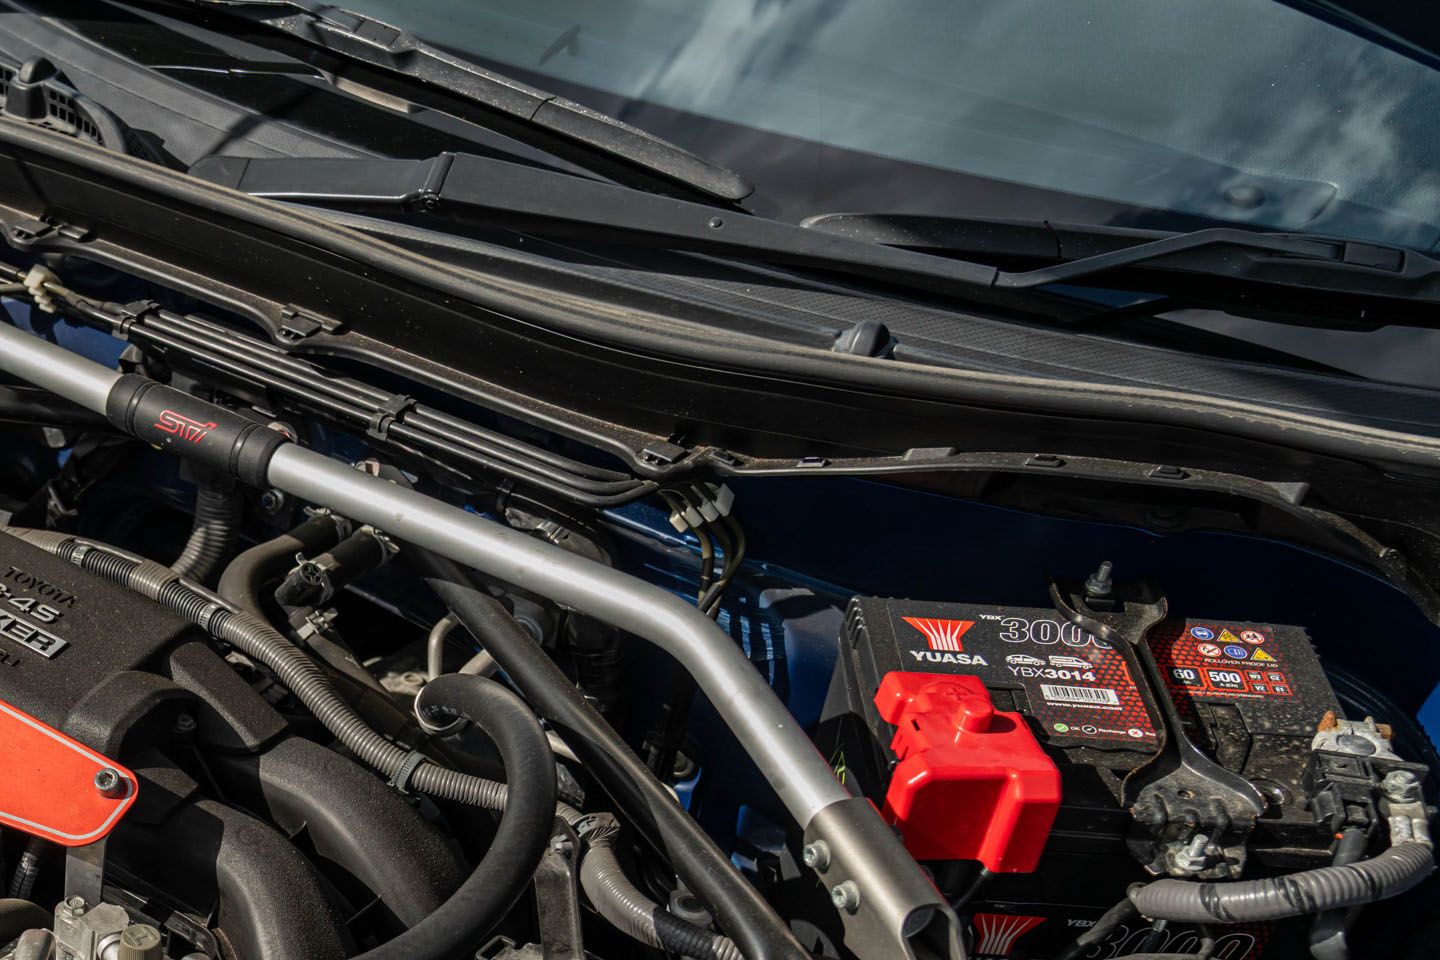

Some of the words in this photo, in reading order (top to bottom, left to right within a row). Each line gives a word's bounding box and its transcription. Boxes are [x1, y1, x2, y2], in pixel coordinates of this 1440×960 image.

[4, 565, 79, 608] TOYOTA
[979, 613, 1003, 621] YBX
[909, 650, 989, 667] YUASA
[1007, 665, 1096, 682] YBX3014
[1173, 668, 1195, 680] 60
[1208, 671, 1241, 683] 500
[1046, 702, 1123, 711] www.yuasa.com
